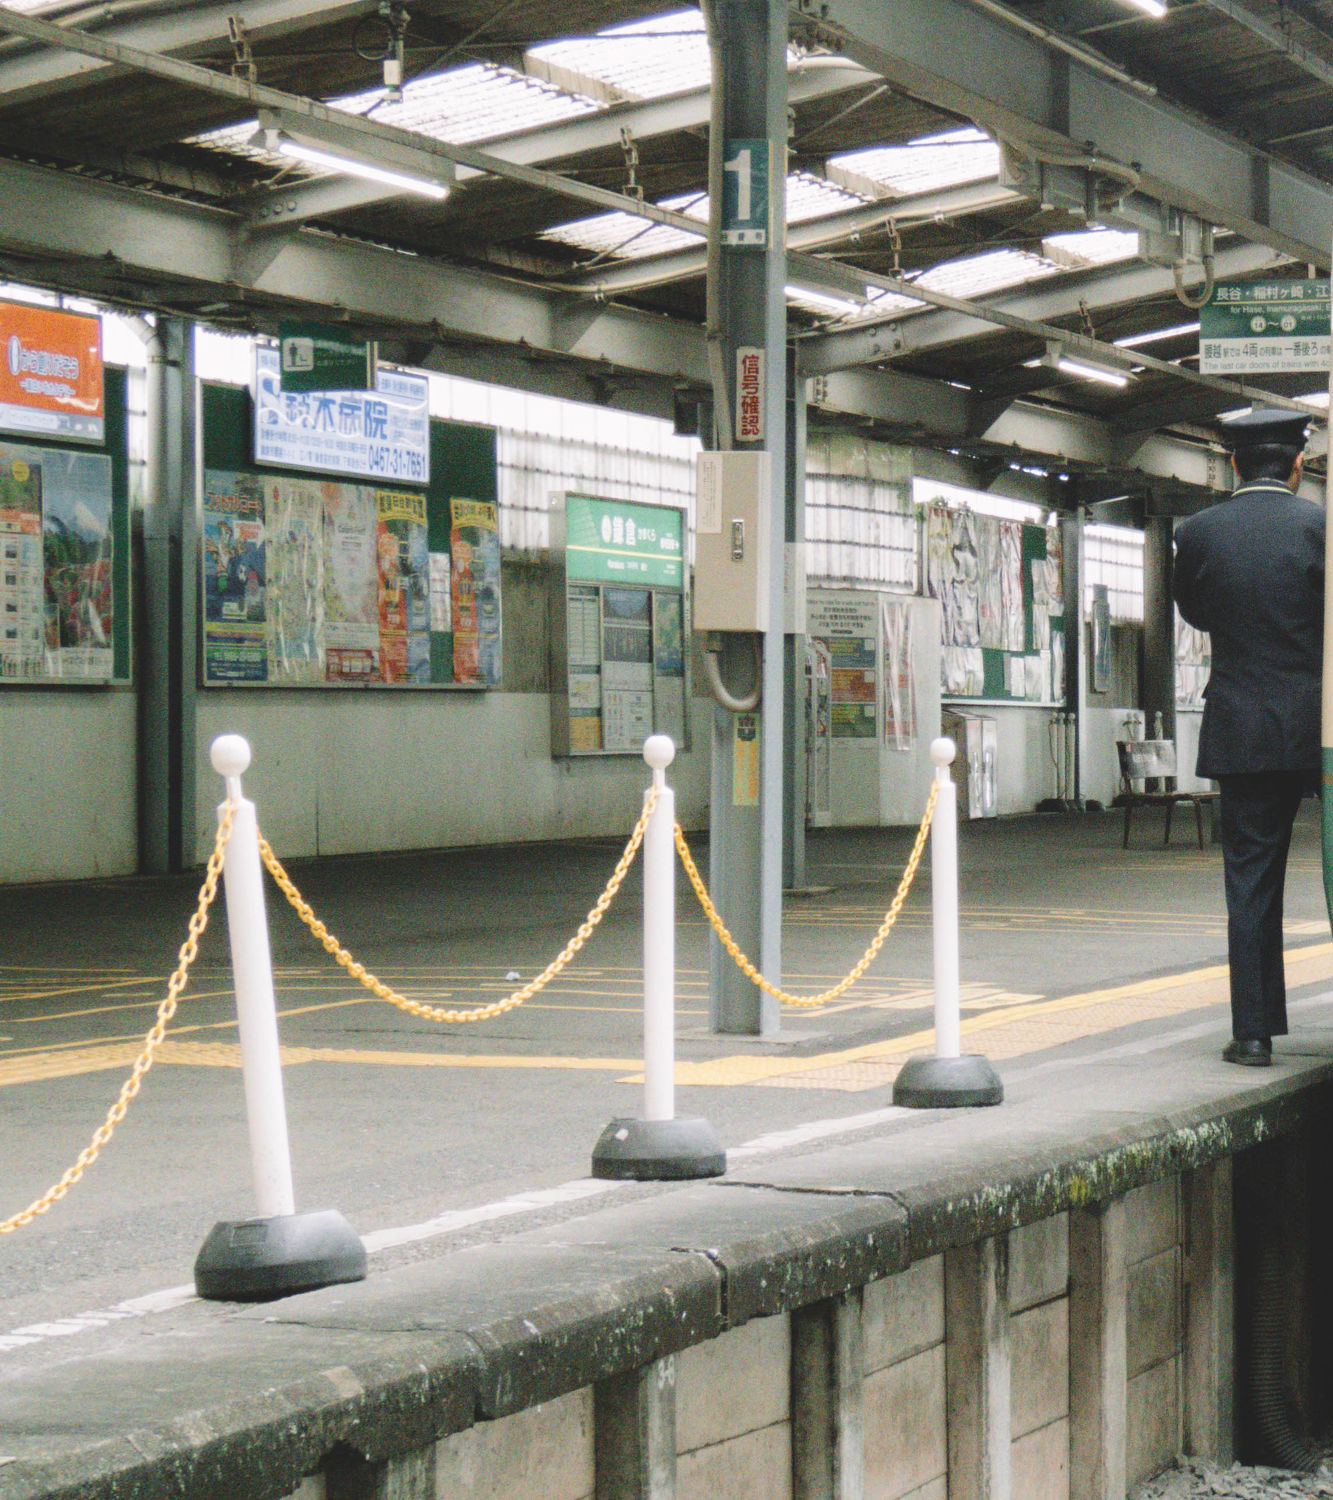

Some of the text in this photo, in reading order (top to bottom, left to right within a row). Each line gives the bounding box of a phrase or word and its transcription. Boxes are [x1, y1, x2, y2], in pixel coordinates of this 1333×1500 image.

[724, 150, 751, 221] 1
[285, 392, 388, 440] 鈴木病院
